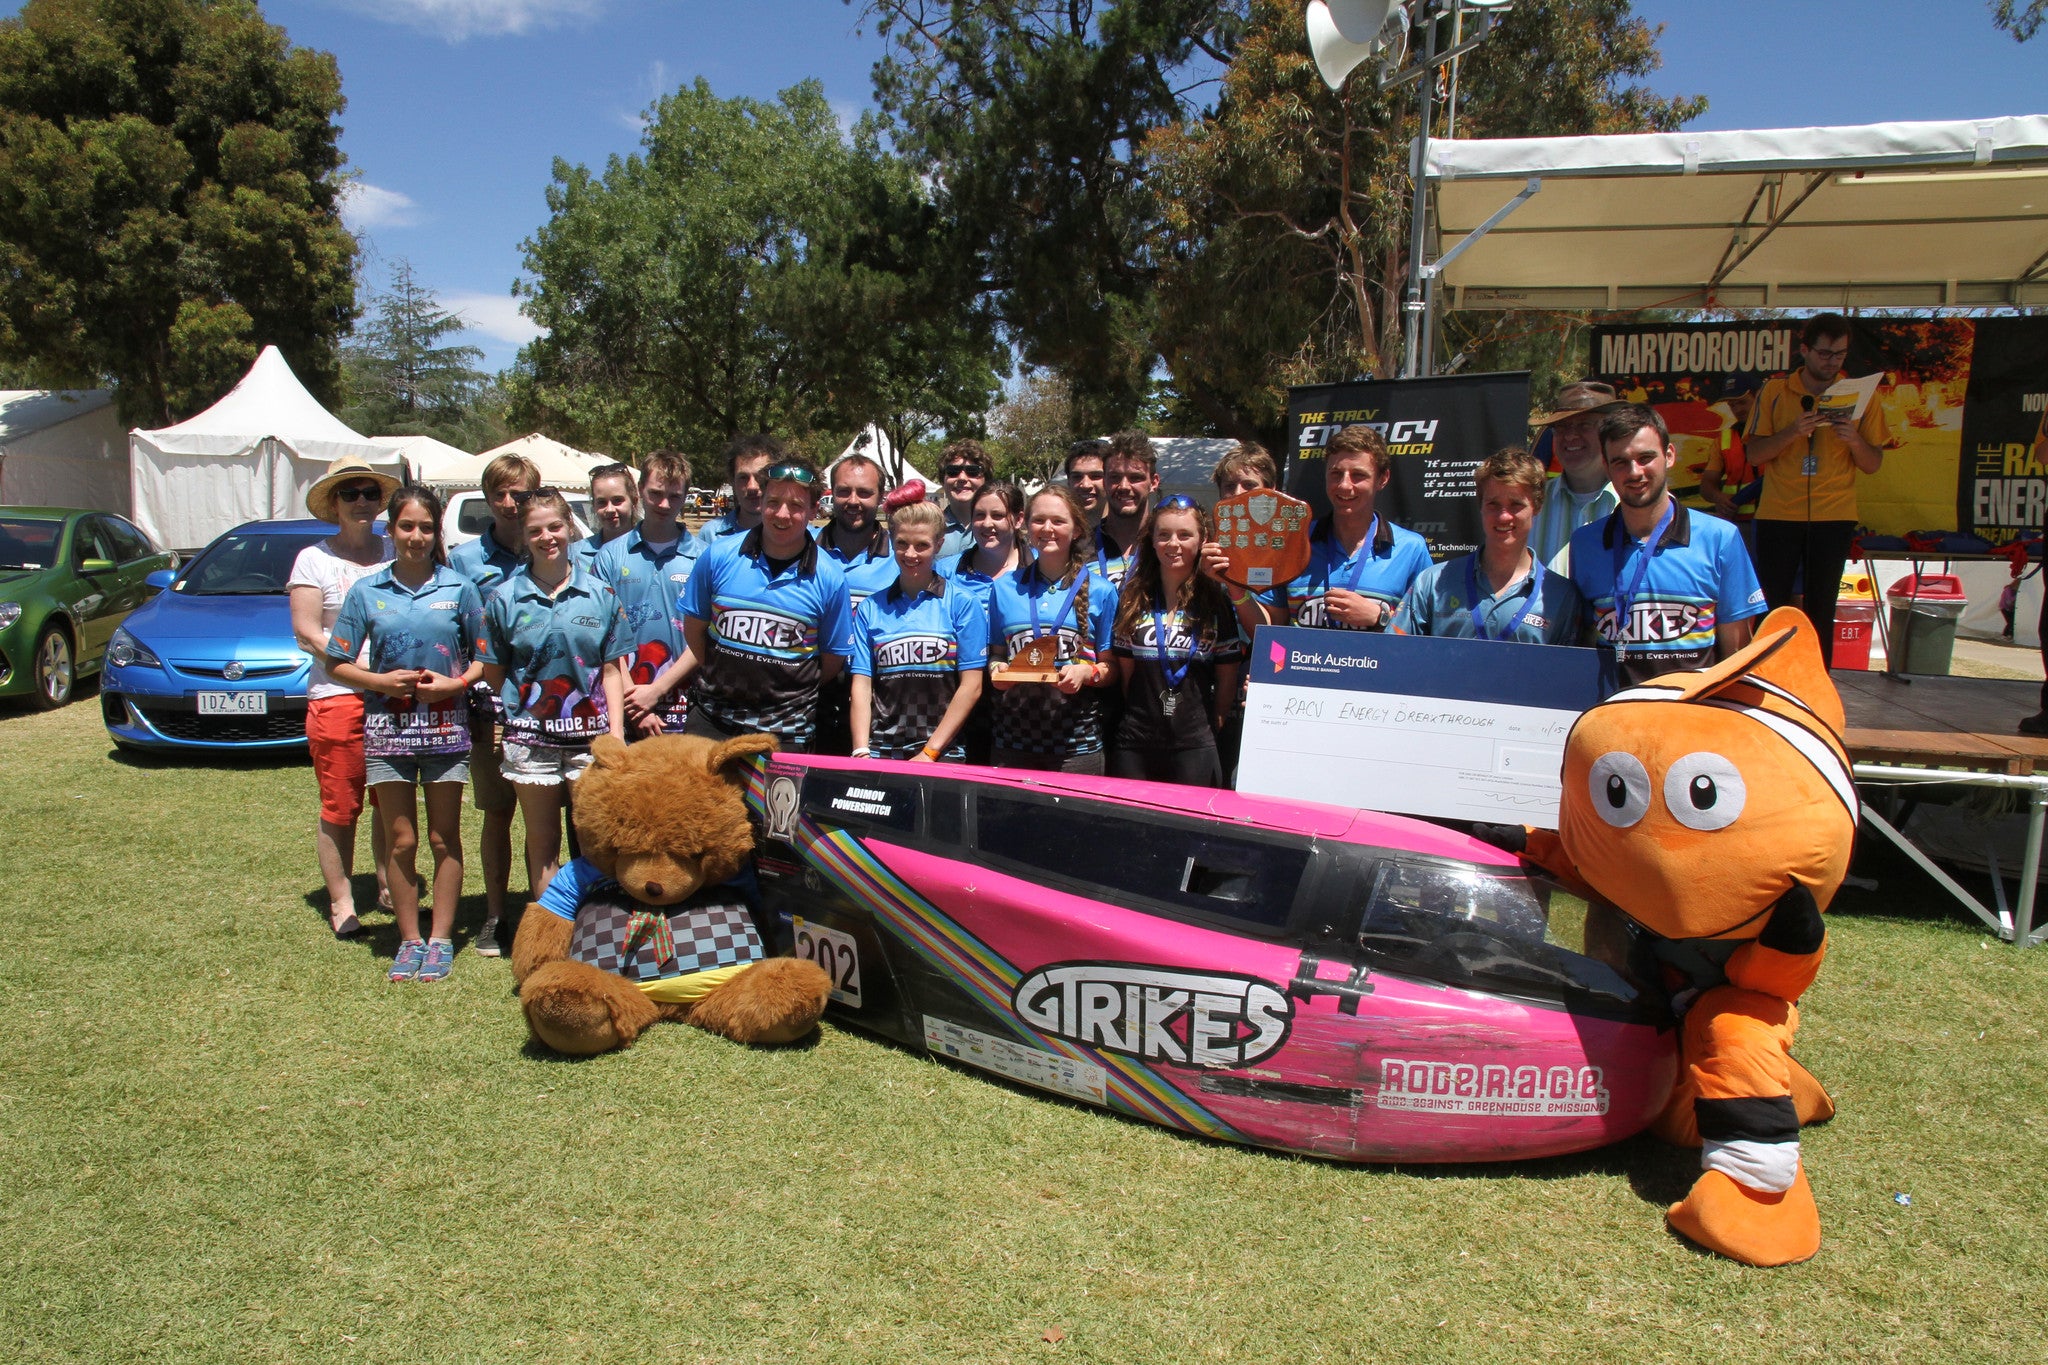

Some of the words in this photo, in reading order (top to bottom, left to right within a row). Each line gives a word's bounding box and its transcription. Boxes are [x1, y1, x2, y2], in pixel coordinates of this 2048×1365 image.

[1600, 329, 1791, 375] MARYBOROUGH
[1299, 411, 1327, 424] THE
[1332, 408, 1380, 422] RACV
[1976, 442, 2003, 475] THE
[1424, 489, 1439, 498] of
[1437, 543, 1478, 552] Technology
[715, 610, 807, 648] GTRIKES
[878, 636, 949, 666] GTRIKES
[1290, 650, 1322, 665] Bank
[1323, 653, 1378, 669] Australia
[1646, 652, 1698, 660] EVERYTHING
[201, 695, 227, 710] 1DZ
[238, 695, 263, 710] 6EI
[1284, 697, 1325, 719] RACV
[1338, 702, 1389, 723] ENERGY
[846, 787, 886, 802] ADIMOV
[831, 798, 892, 816] POWERSWITCH
[798, 931, 859, 996] 202
[1015, 966, 1289, 1064] GTRIKES
